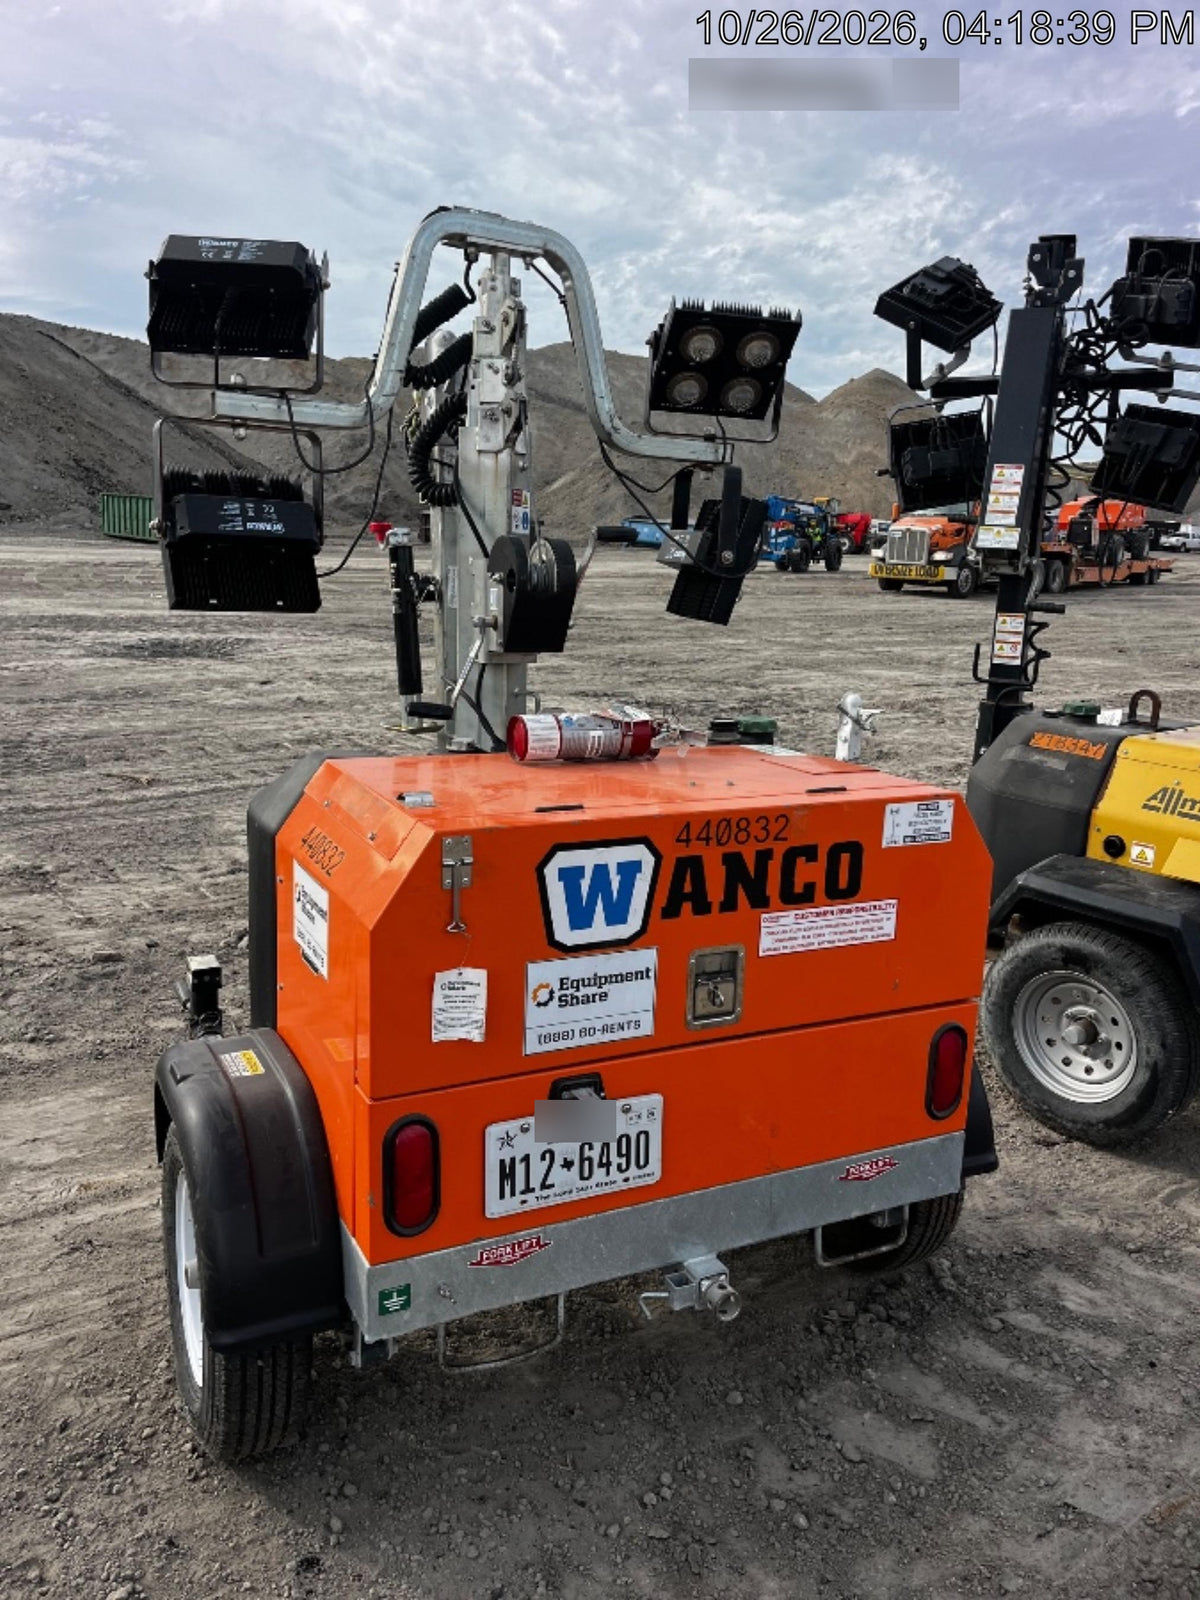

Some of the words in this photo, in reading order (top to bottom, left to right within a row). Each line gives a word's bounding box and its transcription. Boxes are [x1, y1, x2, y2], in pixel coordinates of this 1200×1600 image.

[675, 813, 789, 848] 440832
[557, 840, 864, 932] WANCO
[558, 966, 651, 992] Equipment
[557, 991, 609, 1008] Share
[537, 1029, 575, 1045] (888)
[499, 1147, 556, 1201] M12
[579, 1130, 650, 1182] 6490
